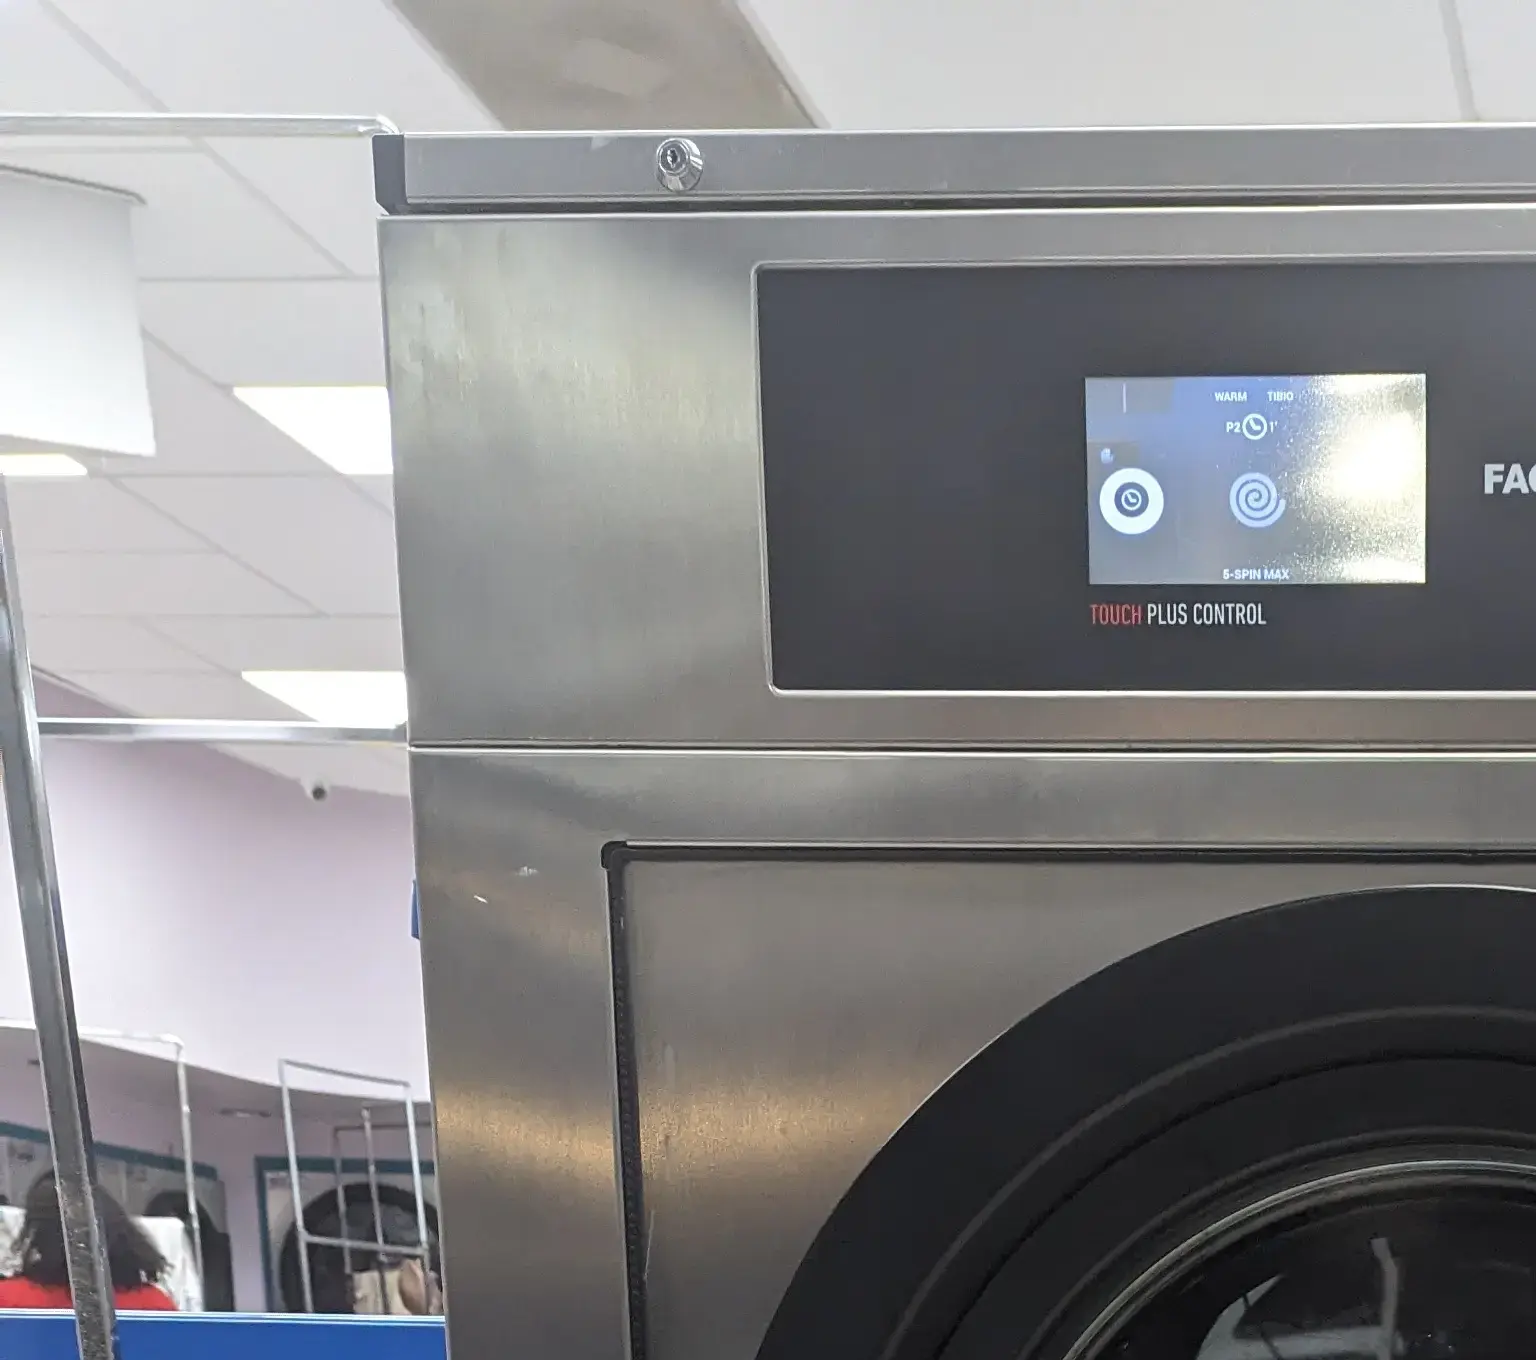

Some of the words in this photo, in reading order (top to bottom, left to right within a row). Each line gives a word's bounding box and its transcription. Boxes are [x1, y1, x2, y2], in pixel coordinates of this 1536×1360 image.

[1214, 391, 1248, 402] WARM
[1226, 421, 1241, 433] P2
[1222, 569, 1262, 580] 5-SPIN
[1264, 568, 1290, 580] MAX
[1089, 604, 1142, 626] TOUCH
[1147, 603, 1188, 625] PLUS
[1193, 603, 1267, 625] CONTROL
